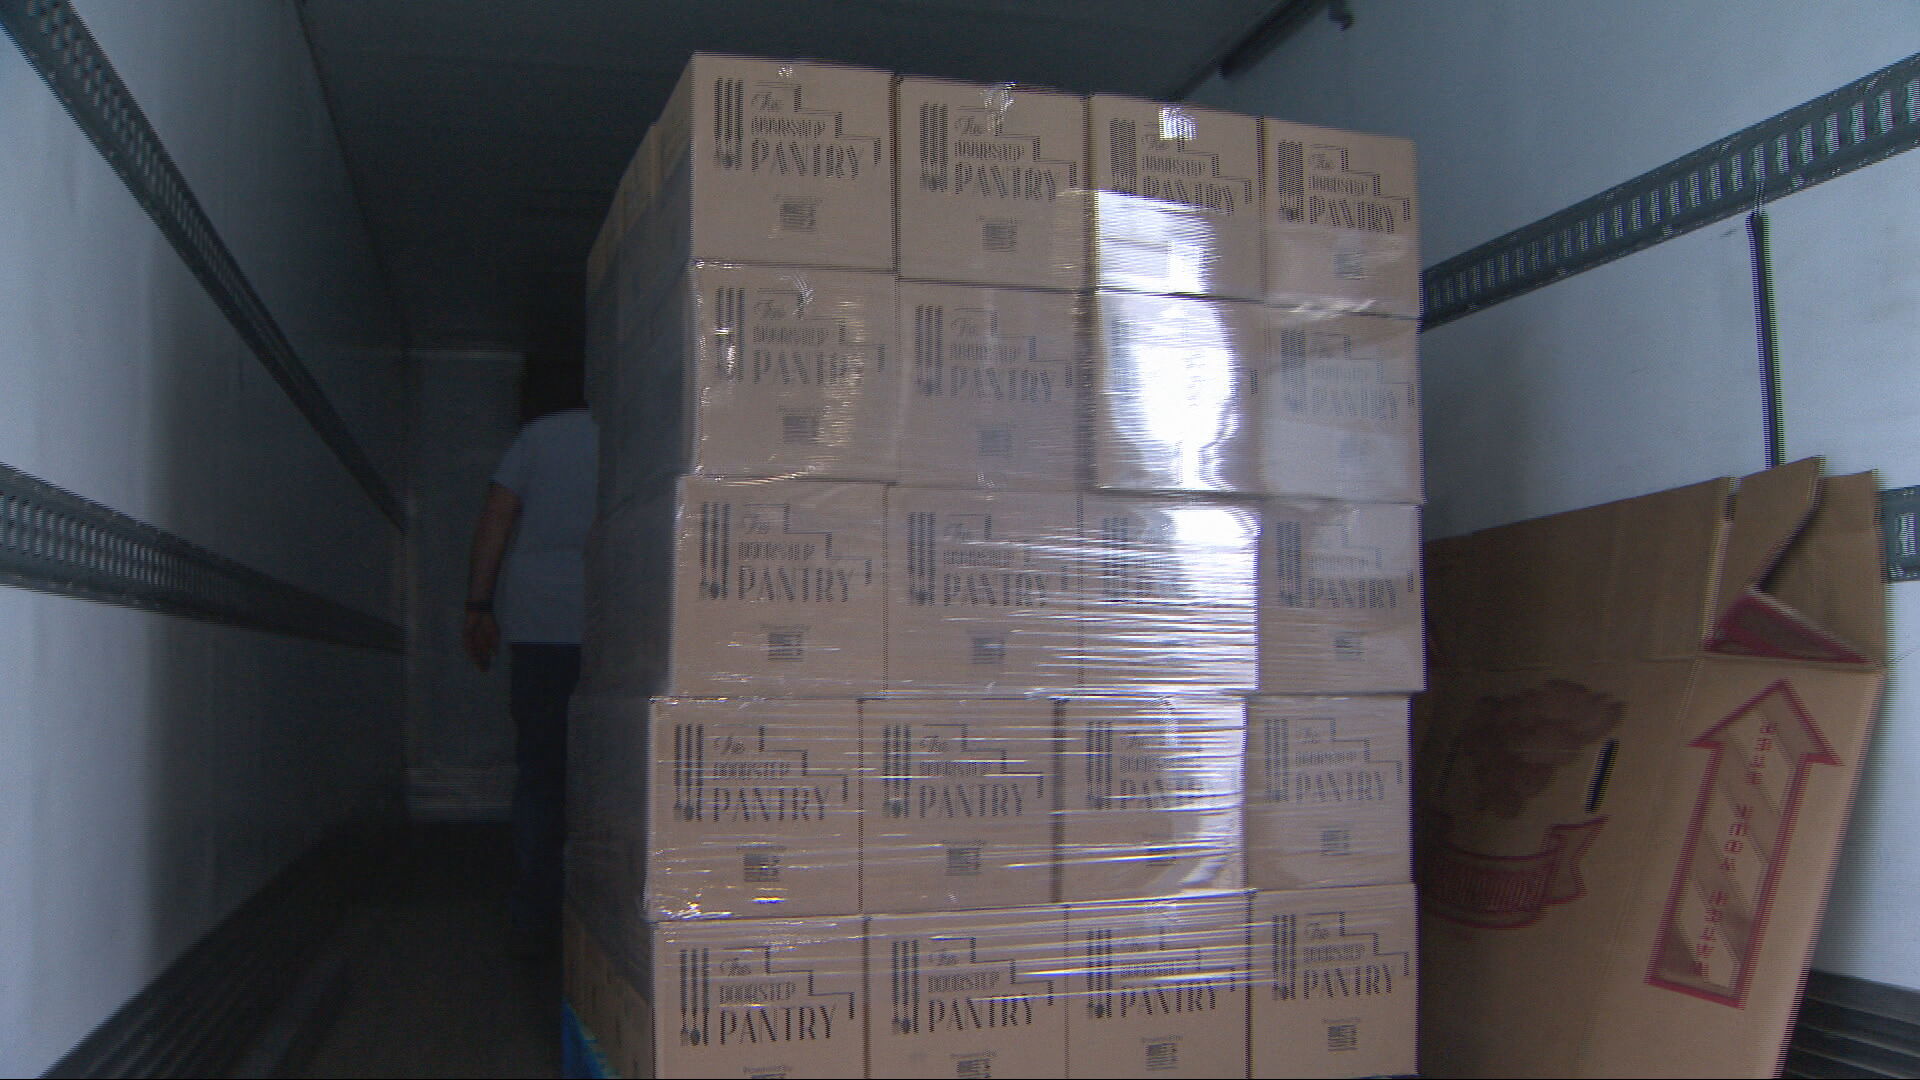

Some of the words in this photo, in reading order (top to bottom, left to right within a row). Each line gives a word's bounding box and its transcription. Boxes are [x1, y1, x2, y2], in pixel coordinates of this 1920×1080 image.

[752, 90, 784, 112] The
[751, 116, 826, 138] DOORSTEP
[953, 113, 986, 135] The
[751, 138, 864, 180] PANTRY
[954, 140, 1025, 162] DOORSTEP
[1307, 152, 1336, 171] The
[1141, 153, 1206, 176] DOORSTEP
[954, 162, 1057, 202] PANTRY
[1307, 174, 1369, 196] DOORSTEP
[1142, 175, 1237, 215] PANTRY
[1308, 195, 1397, 234] PANTRY
[752, 324, 829, 345] DOORSTEP
[950, 341, 1021, 361] DOORSTEP
[950, 364, 1055, 402] PANTRY
[738, 541, 816, 561] DOORSTEP
[943, 548, 1016, 567] DOORSTEP
[738, 565, 856, 603] PANTRY
[943, 571, 1049, 608] PANTRY
[1307, 577, 1399, 609] PANTRY
[713, 735, 746, 754] The
[920, 735, 950, 753] The
[919, 760, 991, 778] DOORSTEP
[1295, 750, 1357, 766] DOORSTEP
[713, 761, 792, 780] DOORSTEP
[1295, 771, 1388, 803] PANTRY
[713, 786, 831, 822] PANTRY
[919, 782, 1027, 818] PANTRY
[1687, 889, 1728, 978] WATCH
[1719, 804, 1753, 872] YOUR
[1745, 720, 1778, 785] STEP
[1304, 922, 1330, 941] The
[1304, 944, 1366, 964] DOORSTEP
[720, 956, 753, 978] The
[928, 970, 1002, 993] DOORSTEP
[1304, 964, 1394, 1000] PANTRY
[720, 982, 797, 1004] DOORSTEP
[1121, 978, 1218, 1019] PANTRY
[720, 1004, 838, 1045] PANTRY
[928, 993, 1038, 1034] PANTRY
